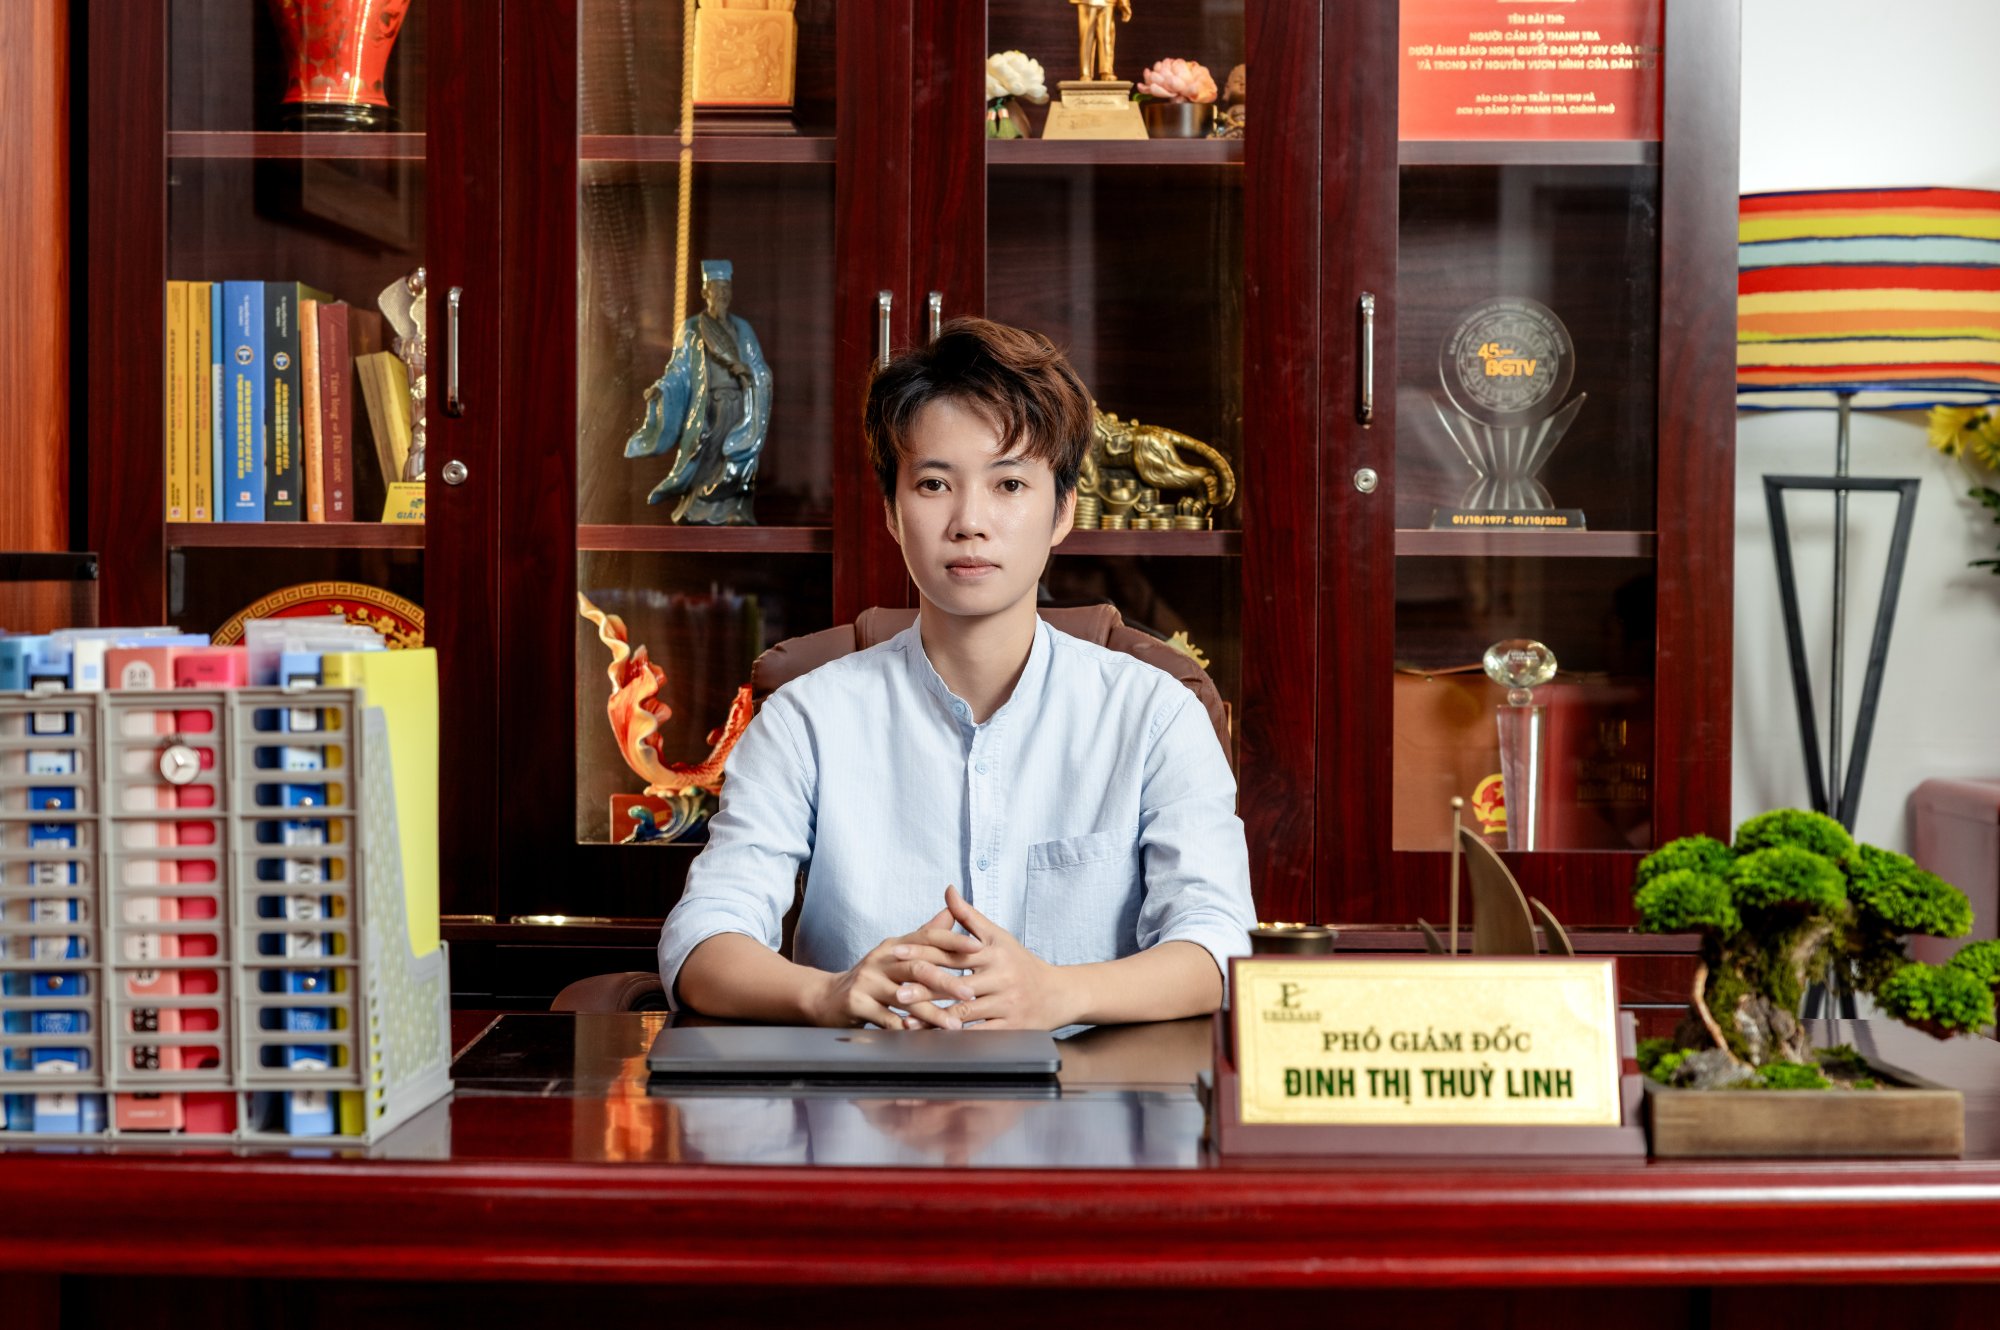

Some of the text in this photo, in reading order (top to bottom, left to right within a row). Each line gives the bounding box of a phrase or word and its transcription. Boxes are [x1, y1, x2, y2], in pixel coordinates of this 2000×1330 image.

[1504, 30, 1528, 41] CÁN
[1546, 31, 1580, 41] THANH
[1581, 31, 1600, 41] TRA
[1458, 44, 1487, 55] SÁNG
[1590, 45, 1609, 55] XIV
[1610, 42, 1633, 55] CỦA
[1433, 60, 1468, 70] TRONG
[1485, 59, 1525, 70] NGUYÊN
[1586, 57, 1609, 70] CỦA
[1477, 342, 1502, 359] 45
[1485, 359, 1537, 377] BGTV
[1452, 515, 1506, 525] 01/10/1977
[1513, 515, 1567, 525] 01/10/2022
[1323, 1025, 1532, 1052] PHÓ GIÁM ĐỐC
[1284, 1062, 1574, 1105] ĐINH THỊ THUỲ LINH
